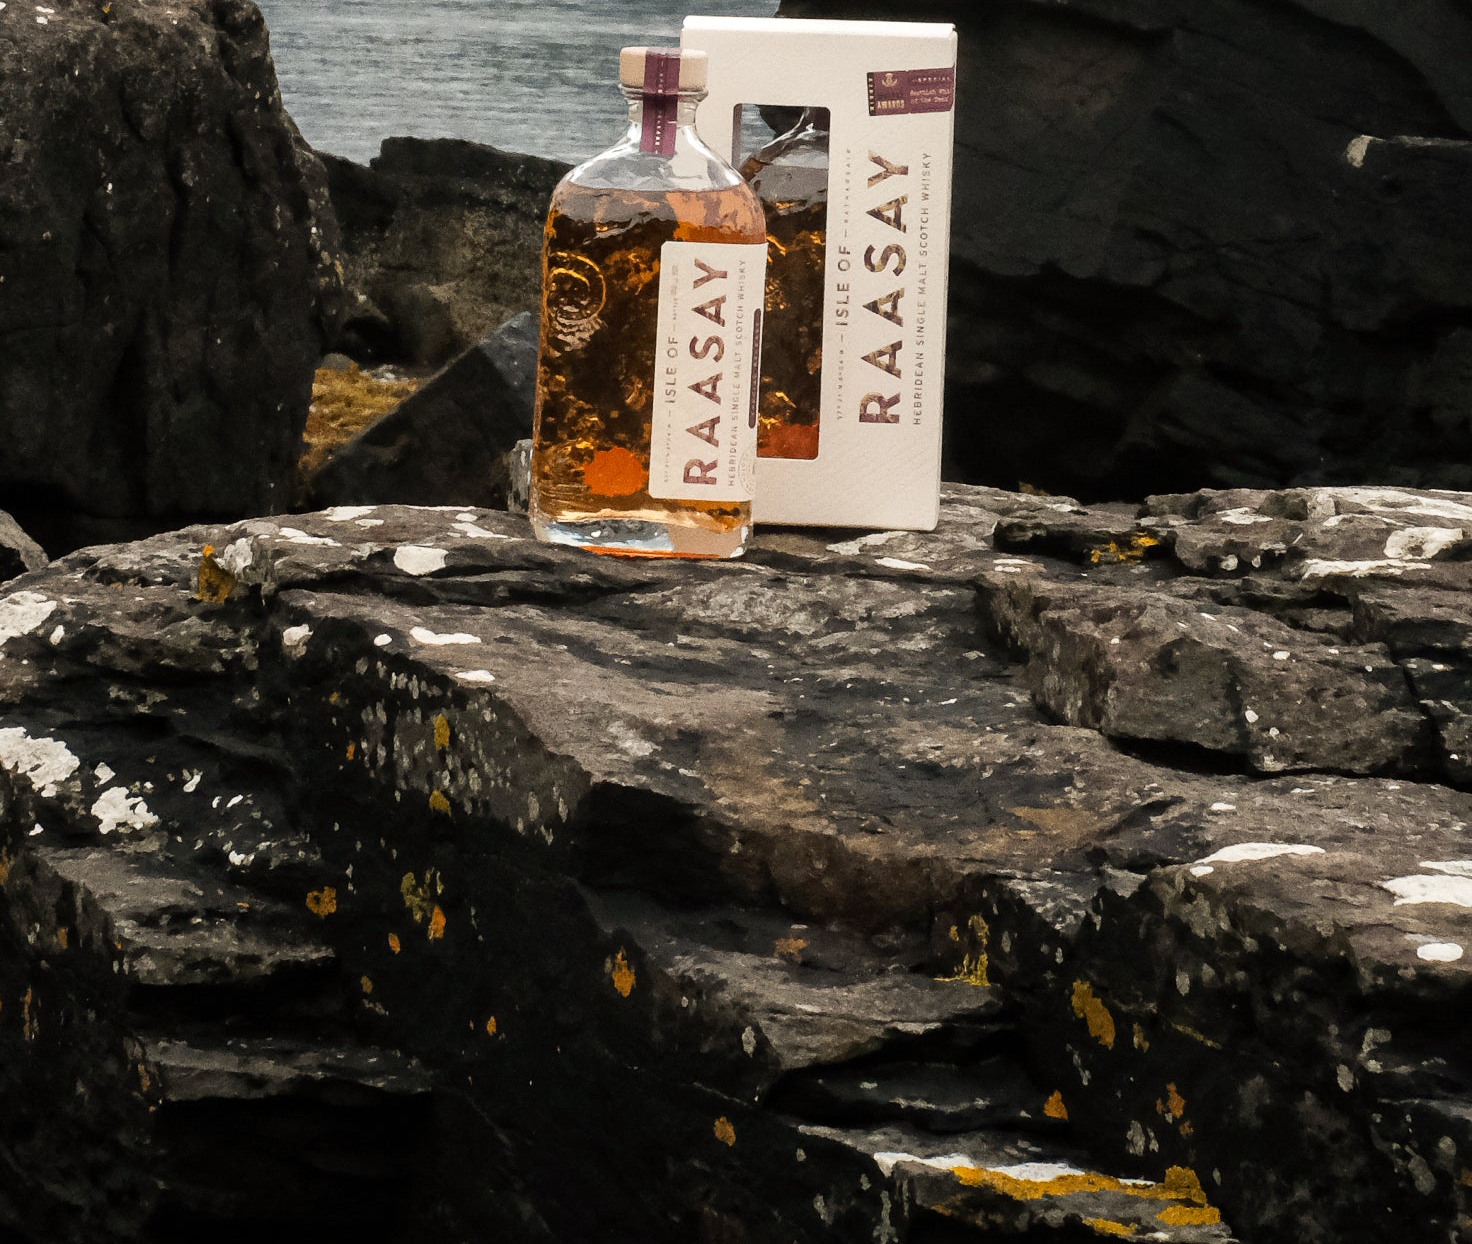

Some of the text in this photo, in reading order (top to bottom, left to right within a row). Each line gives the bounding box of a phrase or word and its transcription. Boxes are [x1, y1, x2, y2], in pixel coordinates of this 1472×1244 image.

[666, 336, 679, 404] ISLE OF
[683, 257, 728, 486] RAASAY
[836, 282, 850, 326] ISLE
[838, 245, 851, 272] OF
[858, 149, 909, 424] RAASAY
[914, 152, 932, 425] HEBRIDEAN SINGLE MALT SCOTCH WHISKY
[728, 260, 746, 487] HEBRIDEAN SINGLE MALT SCOTCH WHISKY
